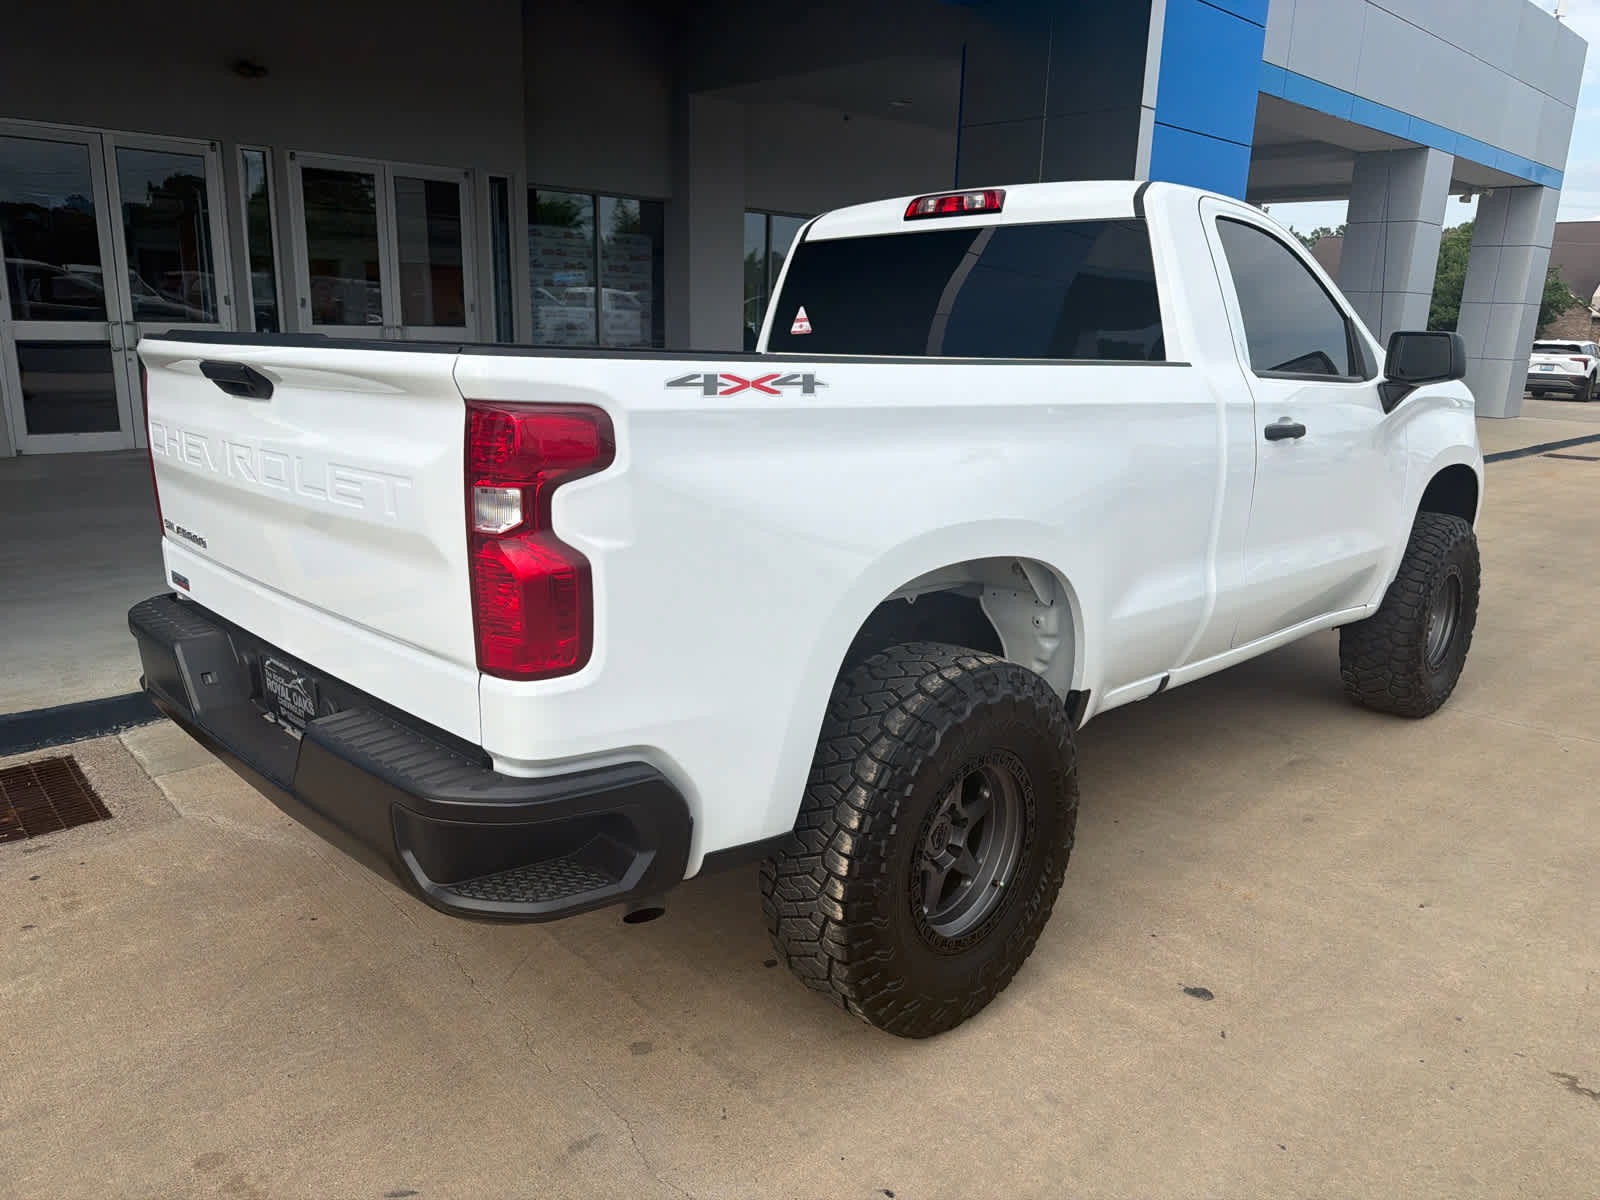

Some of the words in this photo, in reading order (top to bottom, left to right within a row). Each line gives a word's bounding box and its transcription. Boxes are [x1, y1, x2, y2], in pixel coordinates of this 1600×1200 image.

[150, 420, 413, 519] CHEVROLET
[266, 678, 291, 702] ROYAL
[292, 691, 315, 717] OAKS
